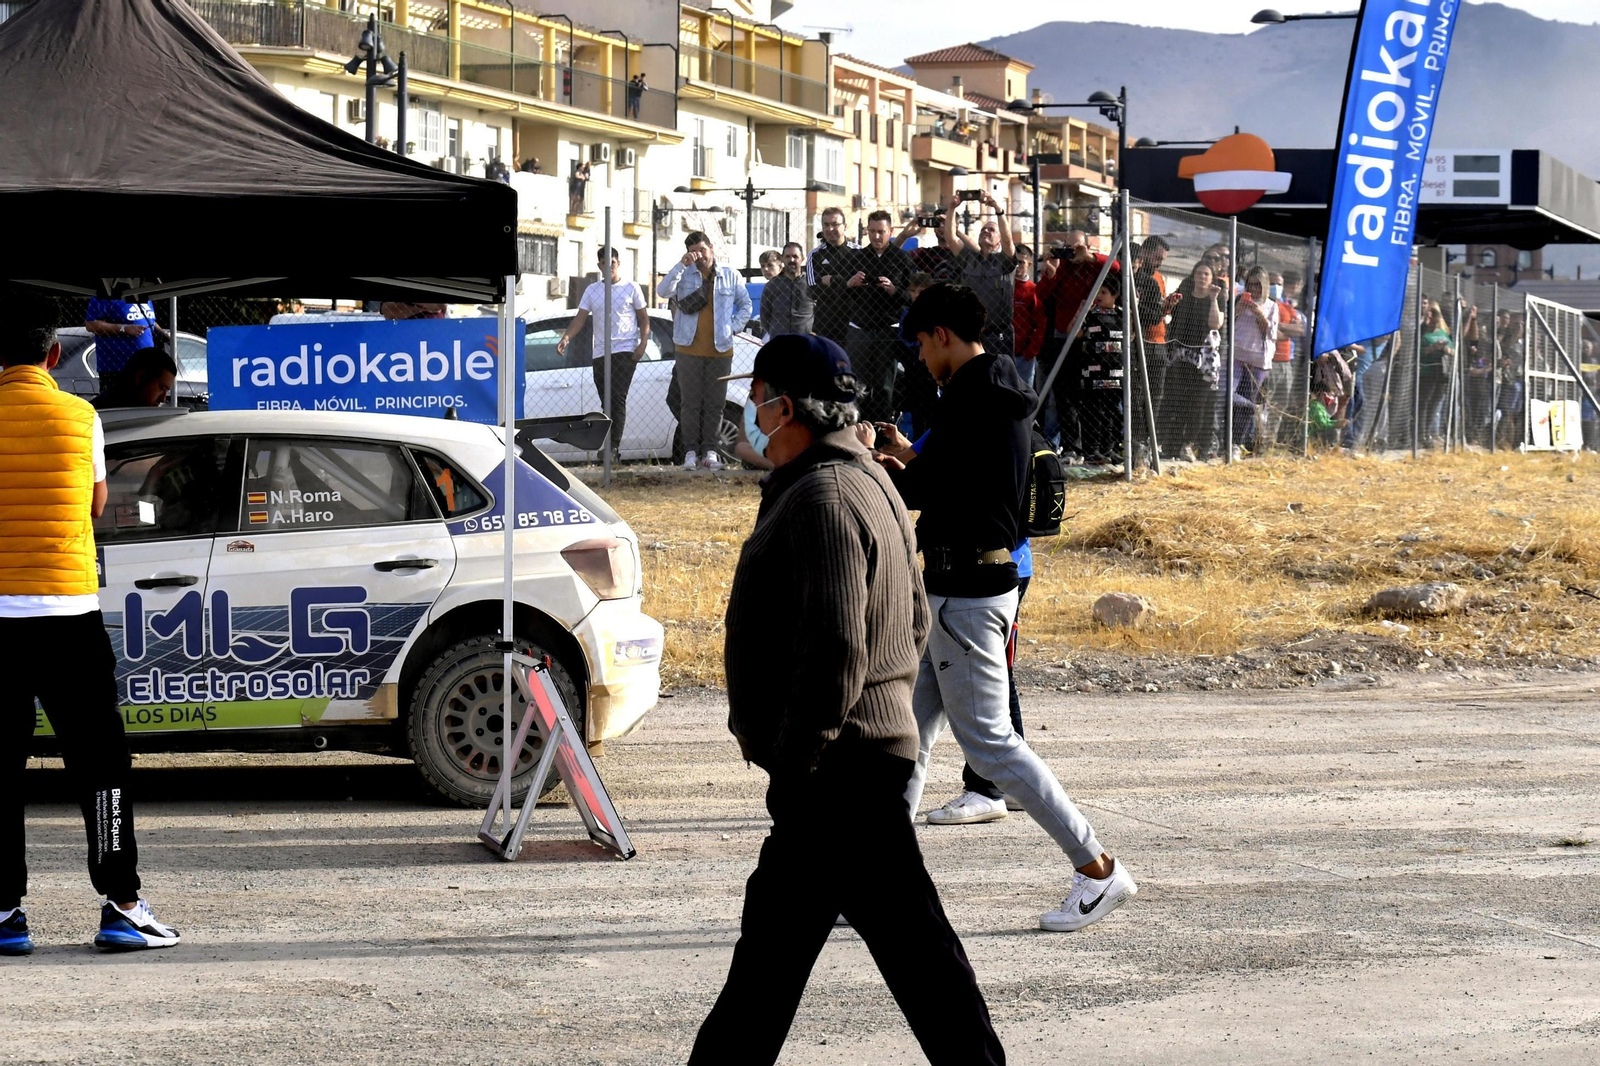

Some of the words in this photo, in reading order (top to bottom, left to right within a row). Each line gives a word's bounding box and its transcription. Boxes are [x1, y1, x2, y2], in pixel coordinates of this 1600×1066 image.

[1342, 0, 1430, 267] radioka
[1390, 173, 1418, 246] FIBRA.
[1405, 84, 1436, 161] MÓVIL.
[1423, 0, 1456, 72] PRINC
[232, 339, 495, 388] radiokable
[314, 395, 367, 411] MÓVIL.
[375, 394, 468, 410] PRINCIPIOS.
[270, 489, 342, 505] N.Roma
[436, 468, 456, 512] 1
[272, 509, 334, 524] A.Haro
[481, 515, 505, 531] 65
[517, 511, 539, 527] 85
[543, 510, 564, 524] 78
[568, 509, 591, 523] 26
[170, 706, 217, 723] DIAS
[111, 788, 121, 817] Black
[111, 818, 122, 851] Squad
